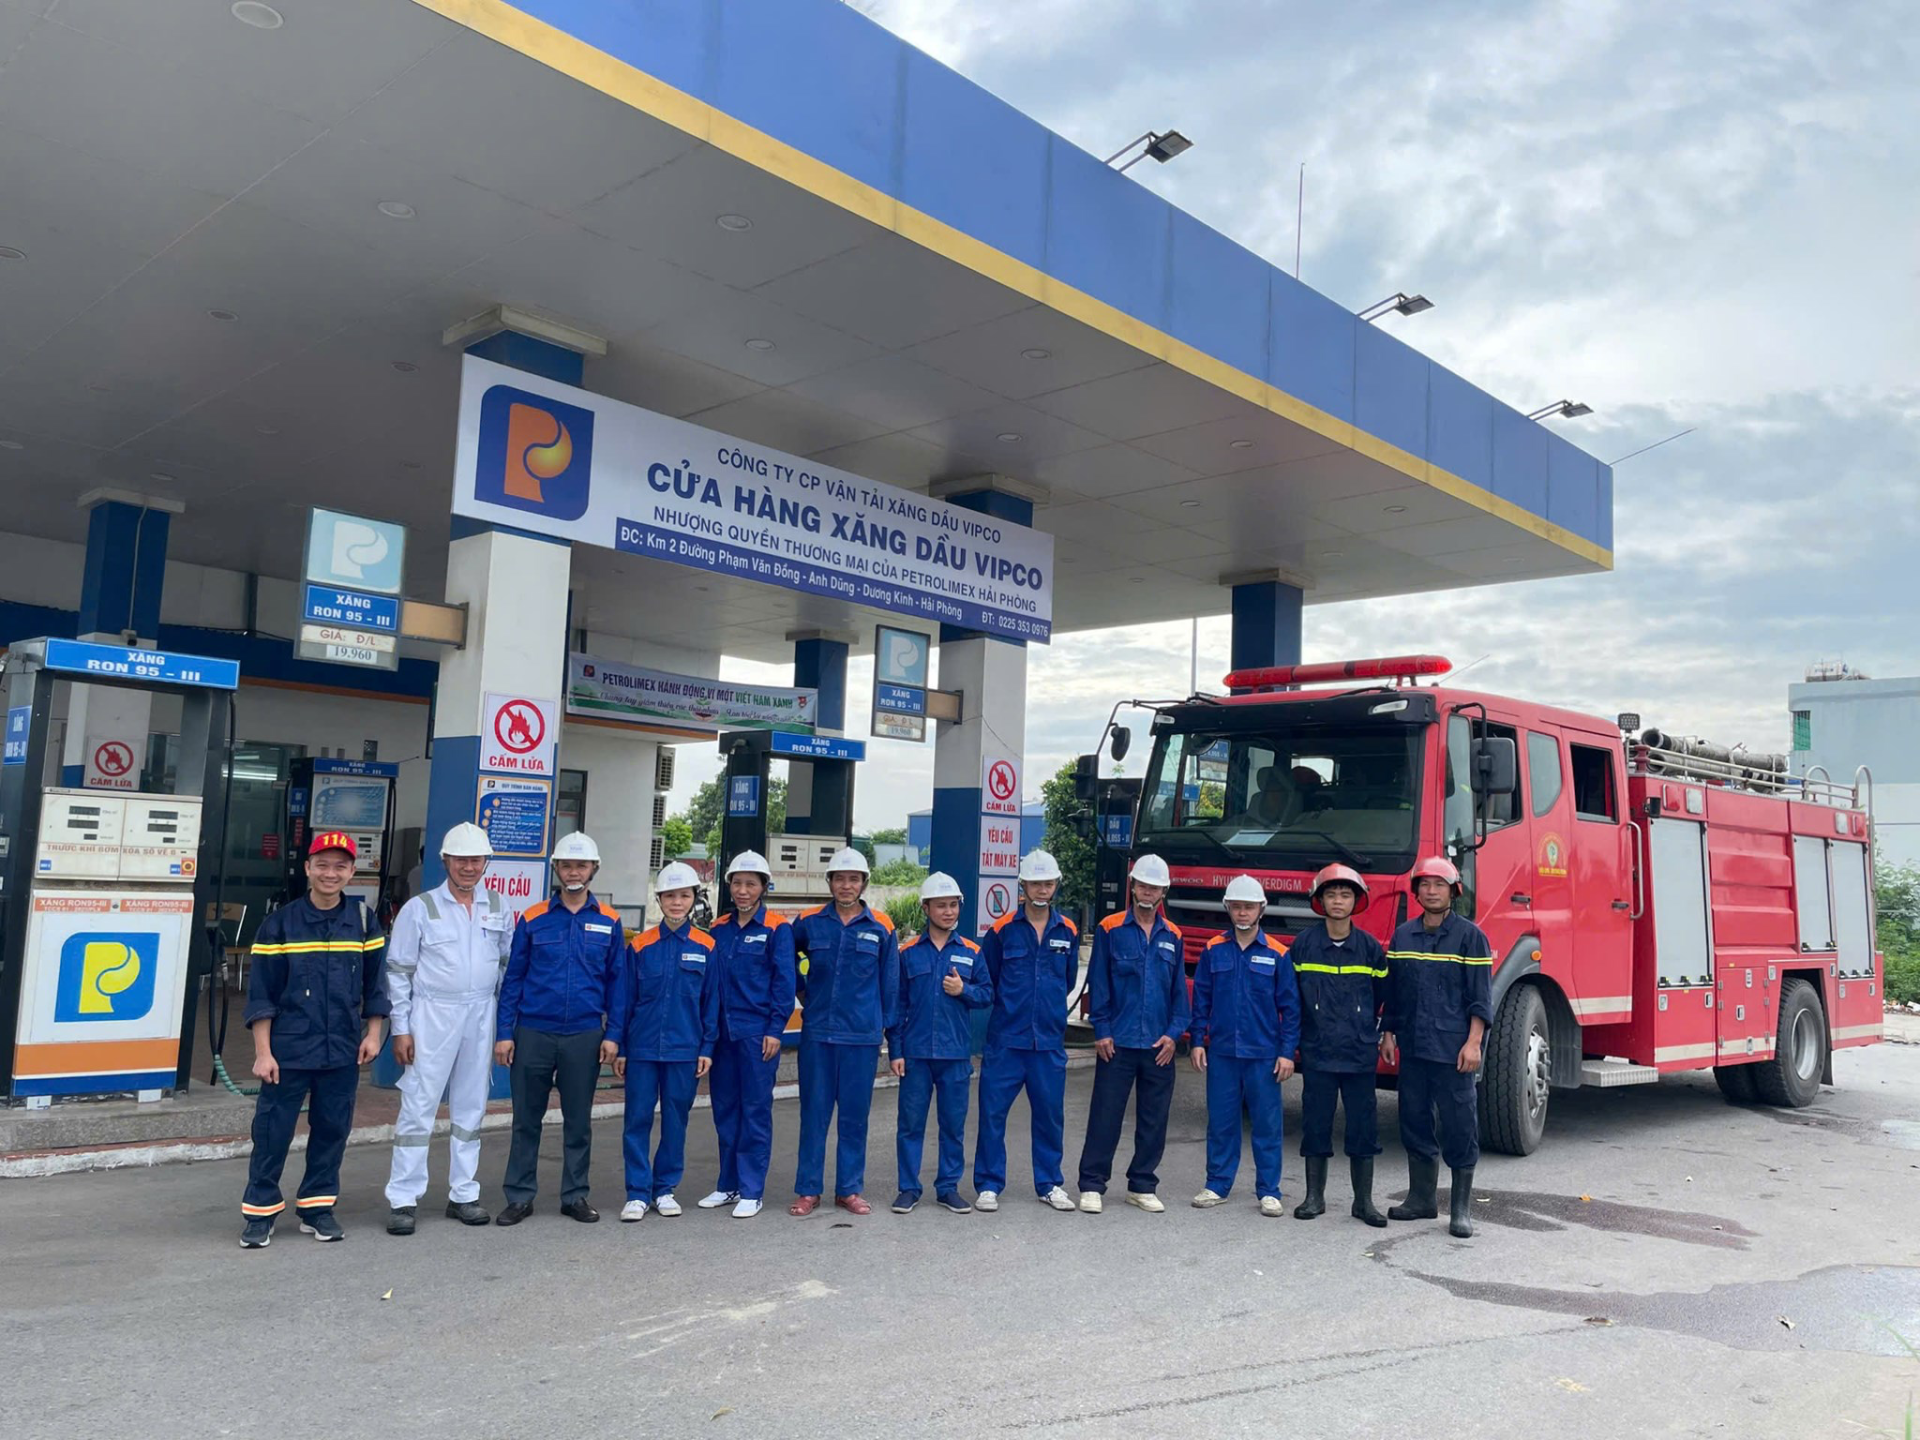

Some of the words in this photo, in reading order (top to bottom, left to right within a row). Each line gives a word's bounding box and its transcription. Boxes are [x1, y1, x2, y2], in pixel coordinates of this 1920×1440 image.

[718, 448, 767, 476] CÔNG
[773, 464, 794, 483] TY
[799, 473, 820, 490] CP
[826, 480, 856, 502] VẬN
[861, 488, 884, 510] TẢI
[888, 498, 927, 522] XĂNG
[932, 509, 958, 531] DẦU
[963, 520, 1001, 543] VIPCO
[647, 459, 722, 508] CỬA
[734, 485, 821, 534] HÀNG
[830, 512, 906, 556] XĂNG
[916, 533, 966, 571] DẦU
[975, 552, 1043, 591] VIPCO
[654, 506, 722, 536] NHƯỢNG
[728, 525, 779, 550] QUYỀN
[784, 539, 841, 565] THƯƠNG
[845, 554, 868, 573] MẠI
[872, 559, 898, 579] CỦA
[901, 569, 975, 598] PETROLIMEX
[978, 586, 997, 603] HẢI
[1000, 593, 1036, 613] PHÒNG
[621, 526, 643, 545] ĐC:
[647, 532, 666, 551] Km
[669, 538, 676, 553] 2
[680, 540, 715, 565] Đường
[719, 549, 748, 570] Phạm
[752, 557, 771, 574] Văn
[774, 562, 800, 584] Đồng
[809, 571, 828, 587] Anh
[830, 576, 855, 596] Dũng
[863, 585, 892, 605] Dương
[894, 590, 914, 607] Kinh
[921, 597, 934, 611] Hải
[936, 602, 962, 620] Phòng
[336, 594, 371, 609] XĂNG
[313, 606, 342, 618] RON
[346, 611, 362, 622] 95
[376, 615, 390, 626] III
[982, 611, 995, 625] ĐT:
[999, 612, 1016, 630] 0225
[1017, 620, 1030, 633] 353
[1032, 623, 1049, 637] 0976
[128, 652, 165, 666] XĂNG
[335, 646, 372, 660] 19.960
[87, 659, 128, 673] RON
[135, 666, 159, 677] 95
[181, 670, 200, 681] III
[602, 672, 656, 692] PETROLIMEX
[753, 694, 771, 707] NAM
[792, 744, 812, 753] RON
[816, 747, 827, 755] 95
[838, 749, 847, 757] III
[811, 738, 830, 747] XĂNG
[489, 753, 518, 768] CẤM
[521, 756, 544, 771] LỬA
[986, 800, 1001, 811] CẤM
[323, 834, 347, 848] 114
[988, 825, 999, 843] YÊU
[1001, 825, 1013, 844] CẦU
[1009, 854, 1017, 868] XE
[508, 871, 531, 897] CẦU
